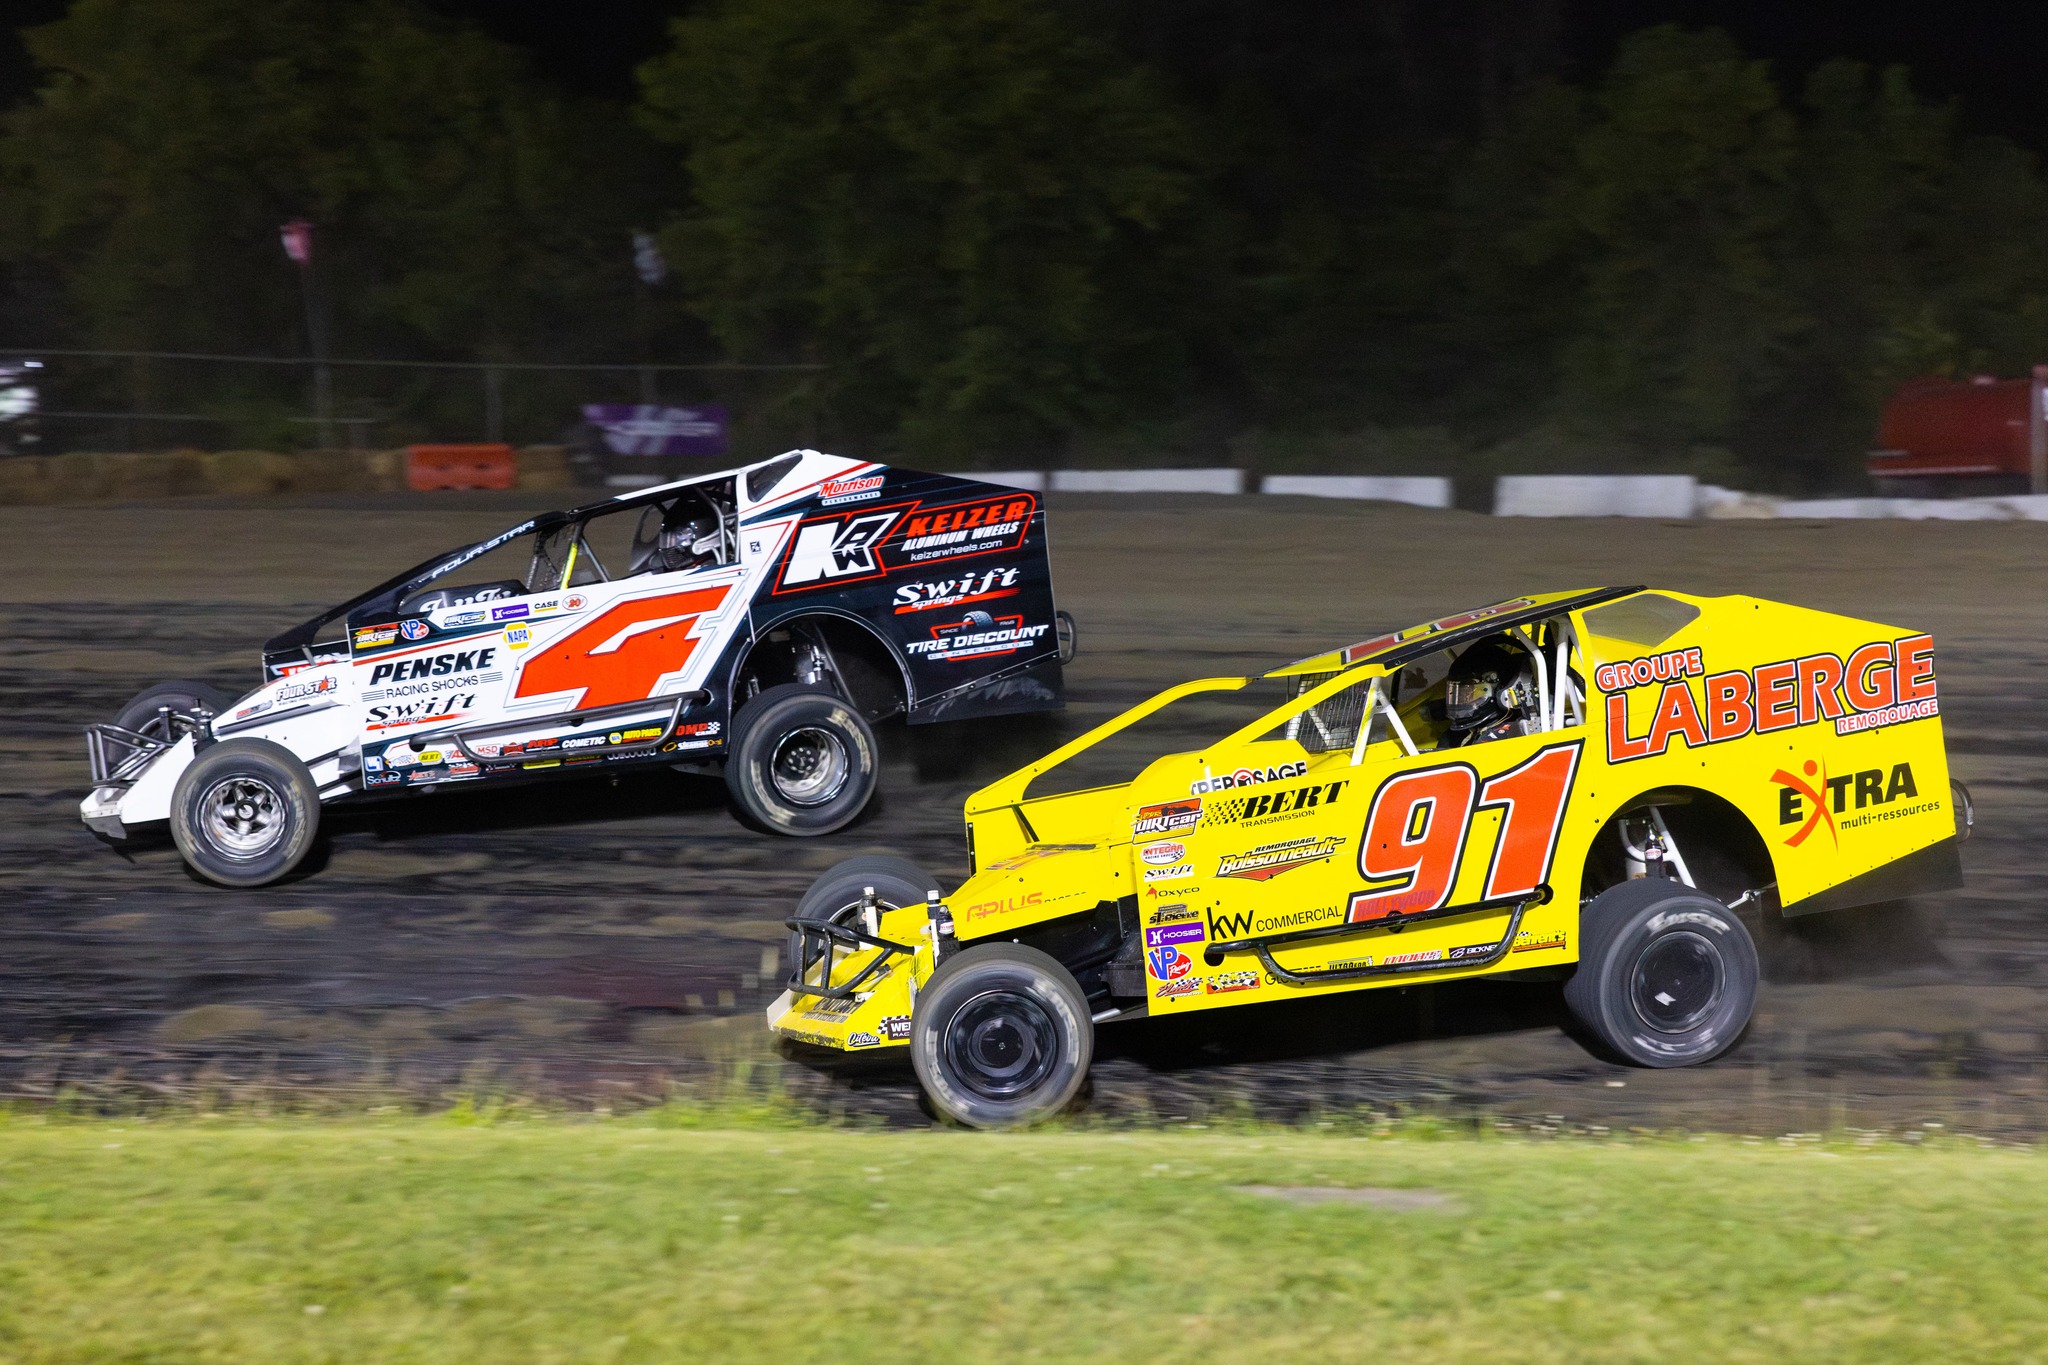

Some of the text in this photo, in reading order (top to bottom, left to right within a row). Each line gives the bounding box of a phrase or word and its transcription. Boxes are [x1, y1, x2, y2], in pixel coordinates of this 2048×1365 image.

[819, 476, 884, 498] Morrison
[906, 501, 1028, 538] KEIZER
[901, 521, 1020, 551] ALUMINUM WHEELS
[431, 520, 536, 579] FOUR STAR
[910, 540, 1003, 562] keizerwheels.com
[534, 600, 559, 610] CASE
[911, 593, 965, 611] springs
[508, 629, 529, 644] NAPA
[906, 624, 1049, 654] TIRE DISCOUNT
[369, 647, 497, 686] PENSKE
[1595, 647, 1704, 693] GROUPE
[276, 684, 305, 702] FOUR
[386, 675, 479, 699] RACING SHOCKS
[1605, 633, 1938, 766] LABERGE
[675, 722, 709, 737] OMP
[1836, 699, 1939, 736] REMORQUAGE
[477, 745, 499, 754] MSD
[562, 736, 606, 749] COMETIC
[1240, 779, 1350, 821] BERT
[1770, 756, 1919, 847] EXTRA
[1134, 808, 1204, 834] DIRTcar
[1240, 809, 1316, 829] TRANSMISSION
[1839, 799, 1941, 831] multi-ressources
[1255, 836, 1317, 853] REMORQUAGE
[1343, 740, 1584, 924] 91
[1143, 844, 1184, 858] INTEGRA
[1218, 837, 1346, 876] Boissonneault
[1158, 887, 1200, 897] Oxyco
[1357, 889, 1436, 919] HOLLYWOOD
[1256, 905, 1343, 932] COMMERCIAL
[1163, 928, 1202, 939] HOOSIER
[1467, 943, 1499, 955] BICKNE
[1147, 945, 1178, 981] VP
[1169, 960, 1192, 975] Racing
